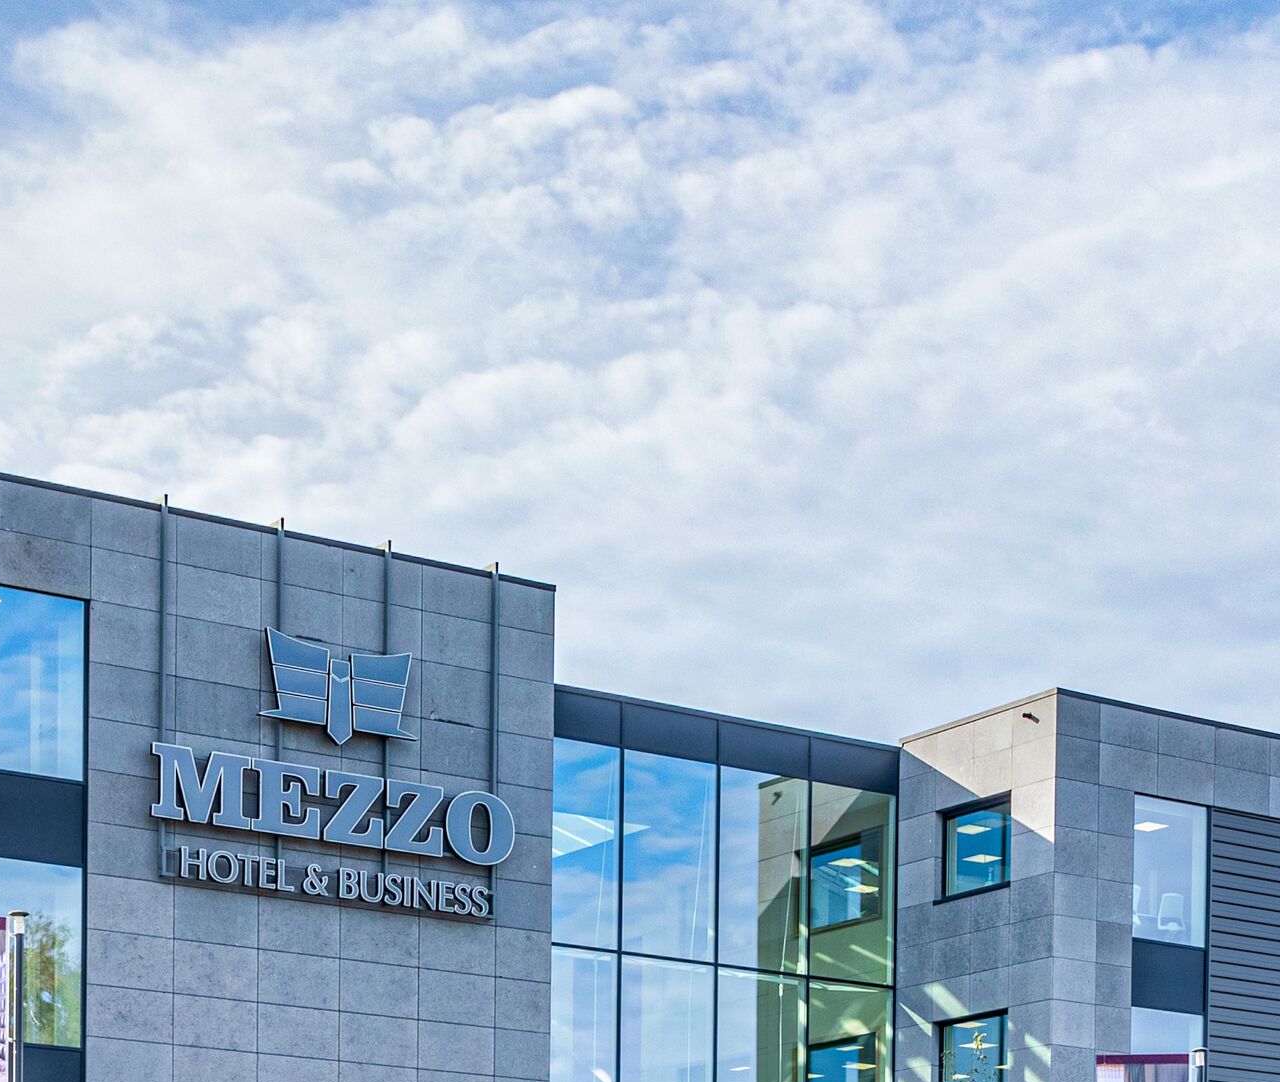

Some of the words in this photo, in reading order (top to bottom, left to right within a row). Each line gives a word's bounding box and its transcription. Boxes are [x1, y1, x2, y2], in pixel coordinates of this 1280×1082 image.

[150, 741, 516, 866] MEZZO
[179, 845, 295, 892] HOTEL
[302, 863, 329, 896] &
[338, 867, 490, 917] BUSINESS
